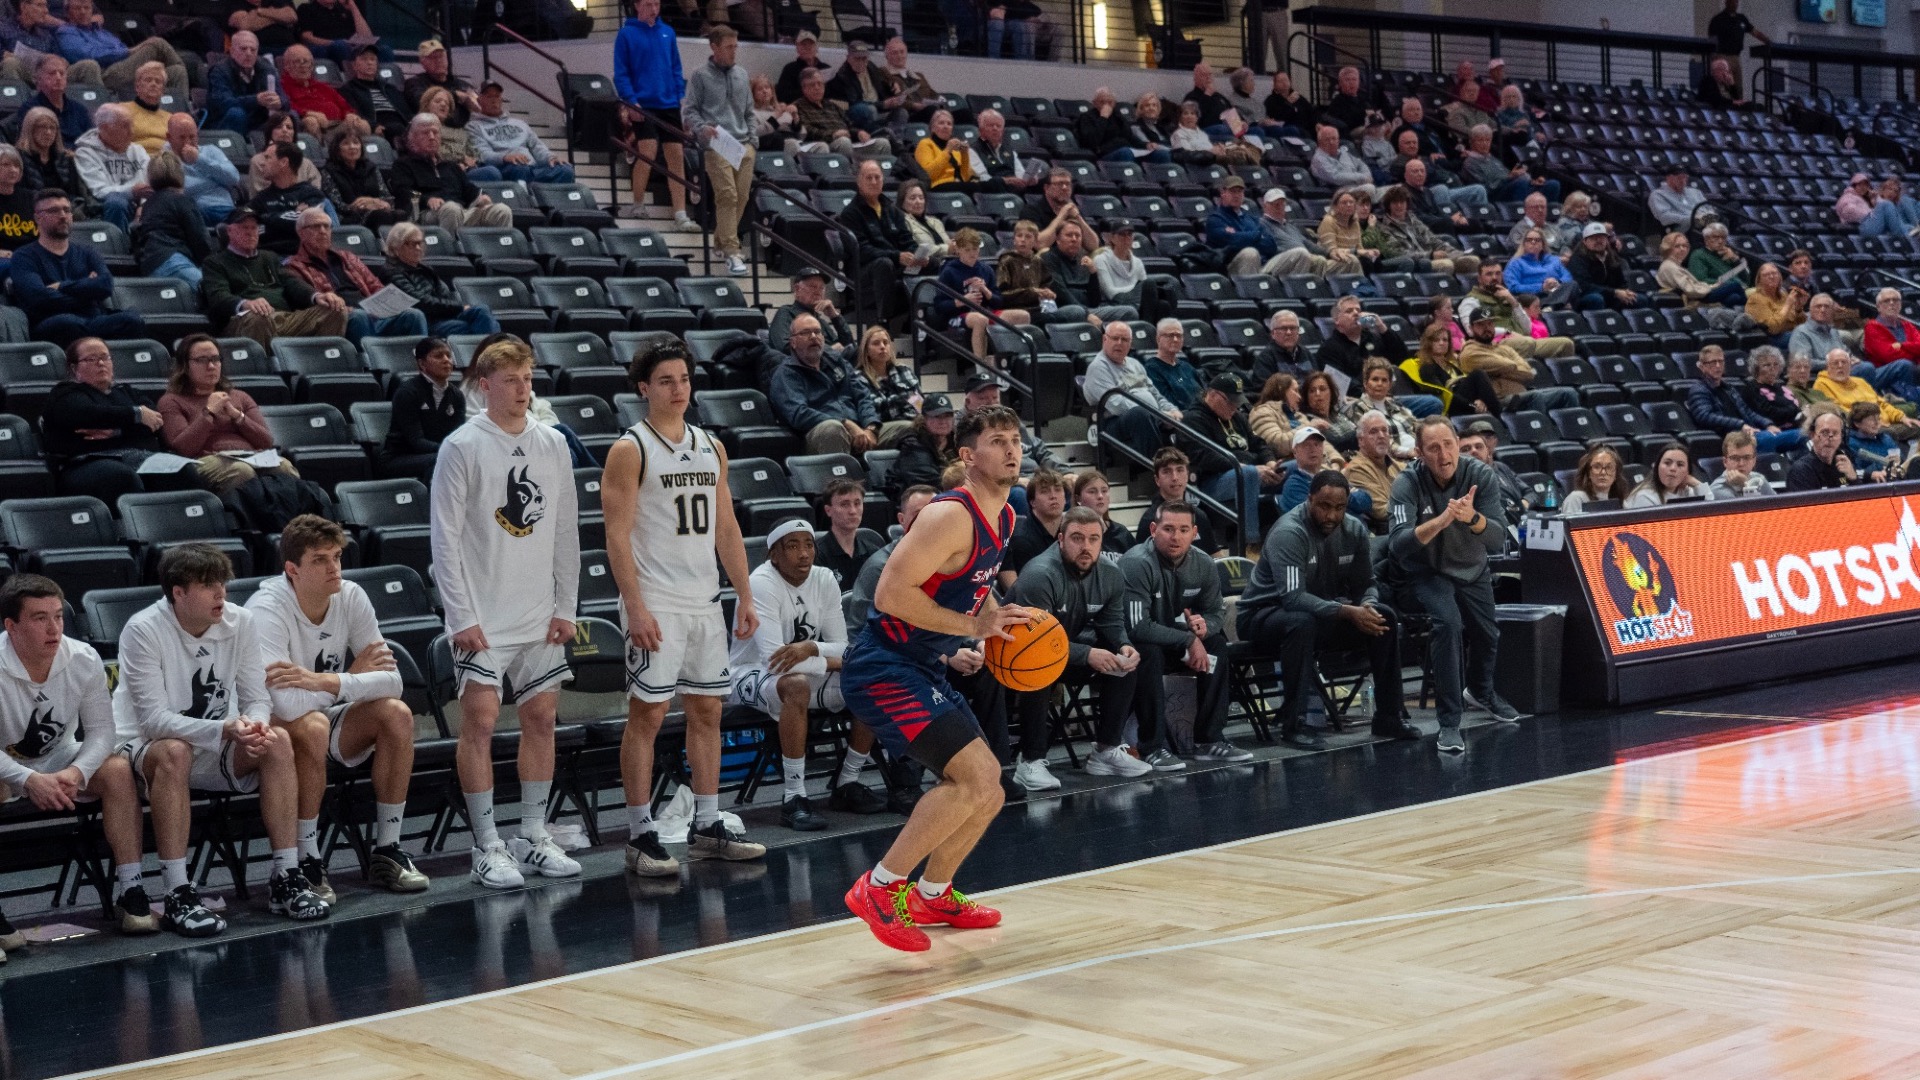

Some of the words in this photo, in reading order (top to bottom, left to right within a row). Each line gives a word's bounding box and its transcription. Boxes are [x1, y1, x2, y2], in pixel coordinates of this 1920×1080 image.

[660, 472, 716, 489] WOFFORD
[674, 493, 709, 537] 10
[1615, 603, 1693, 644] HOTSPOT
